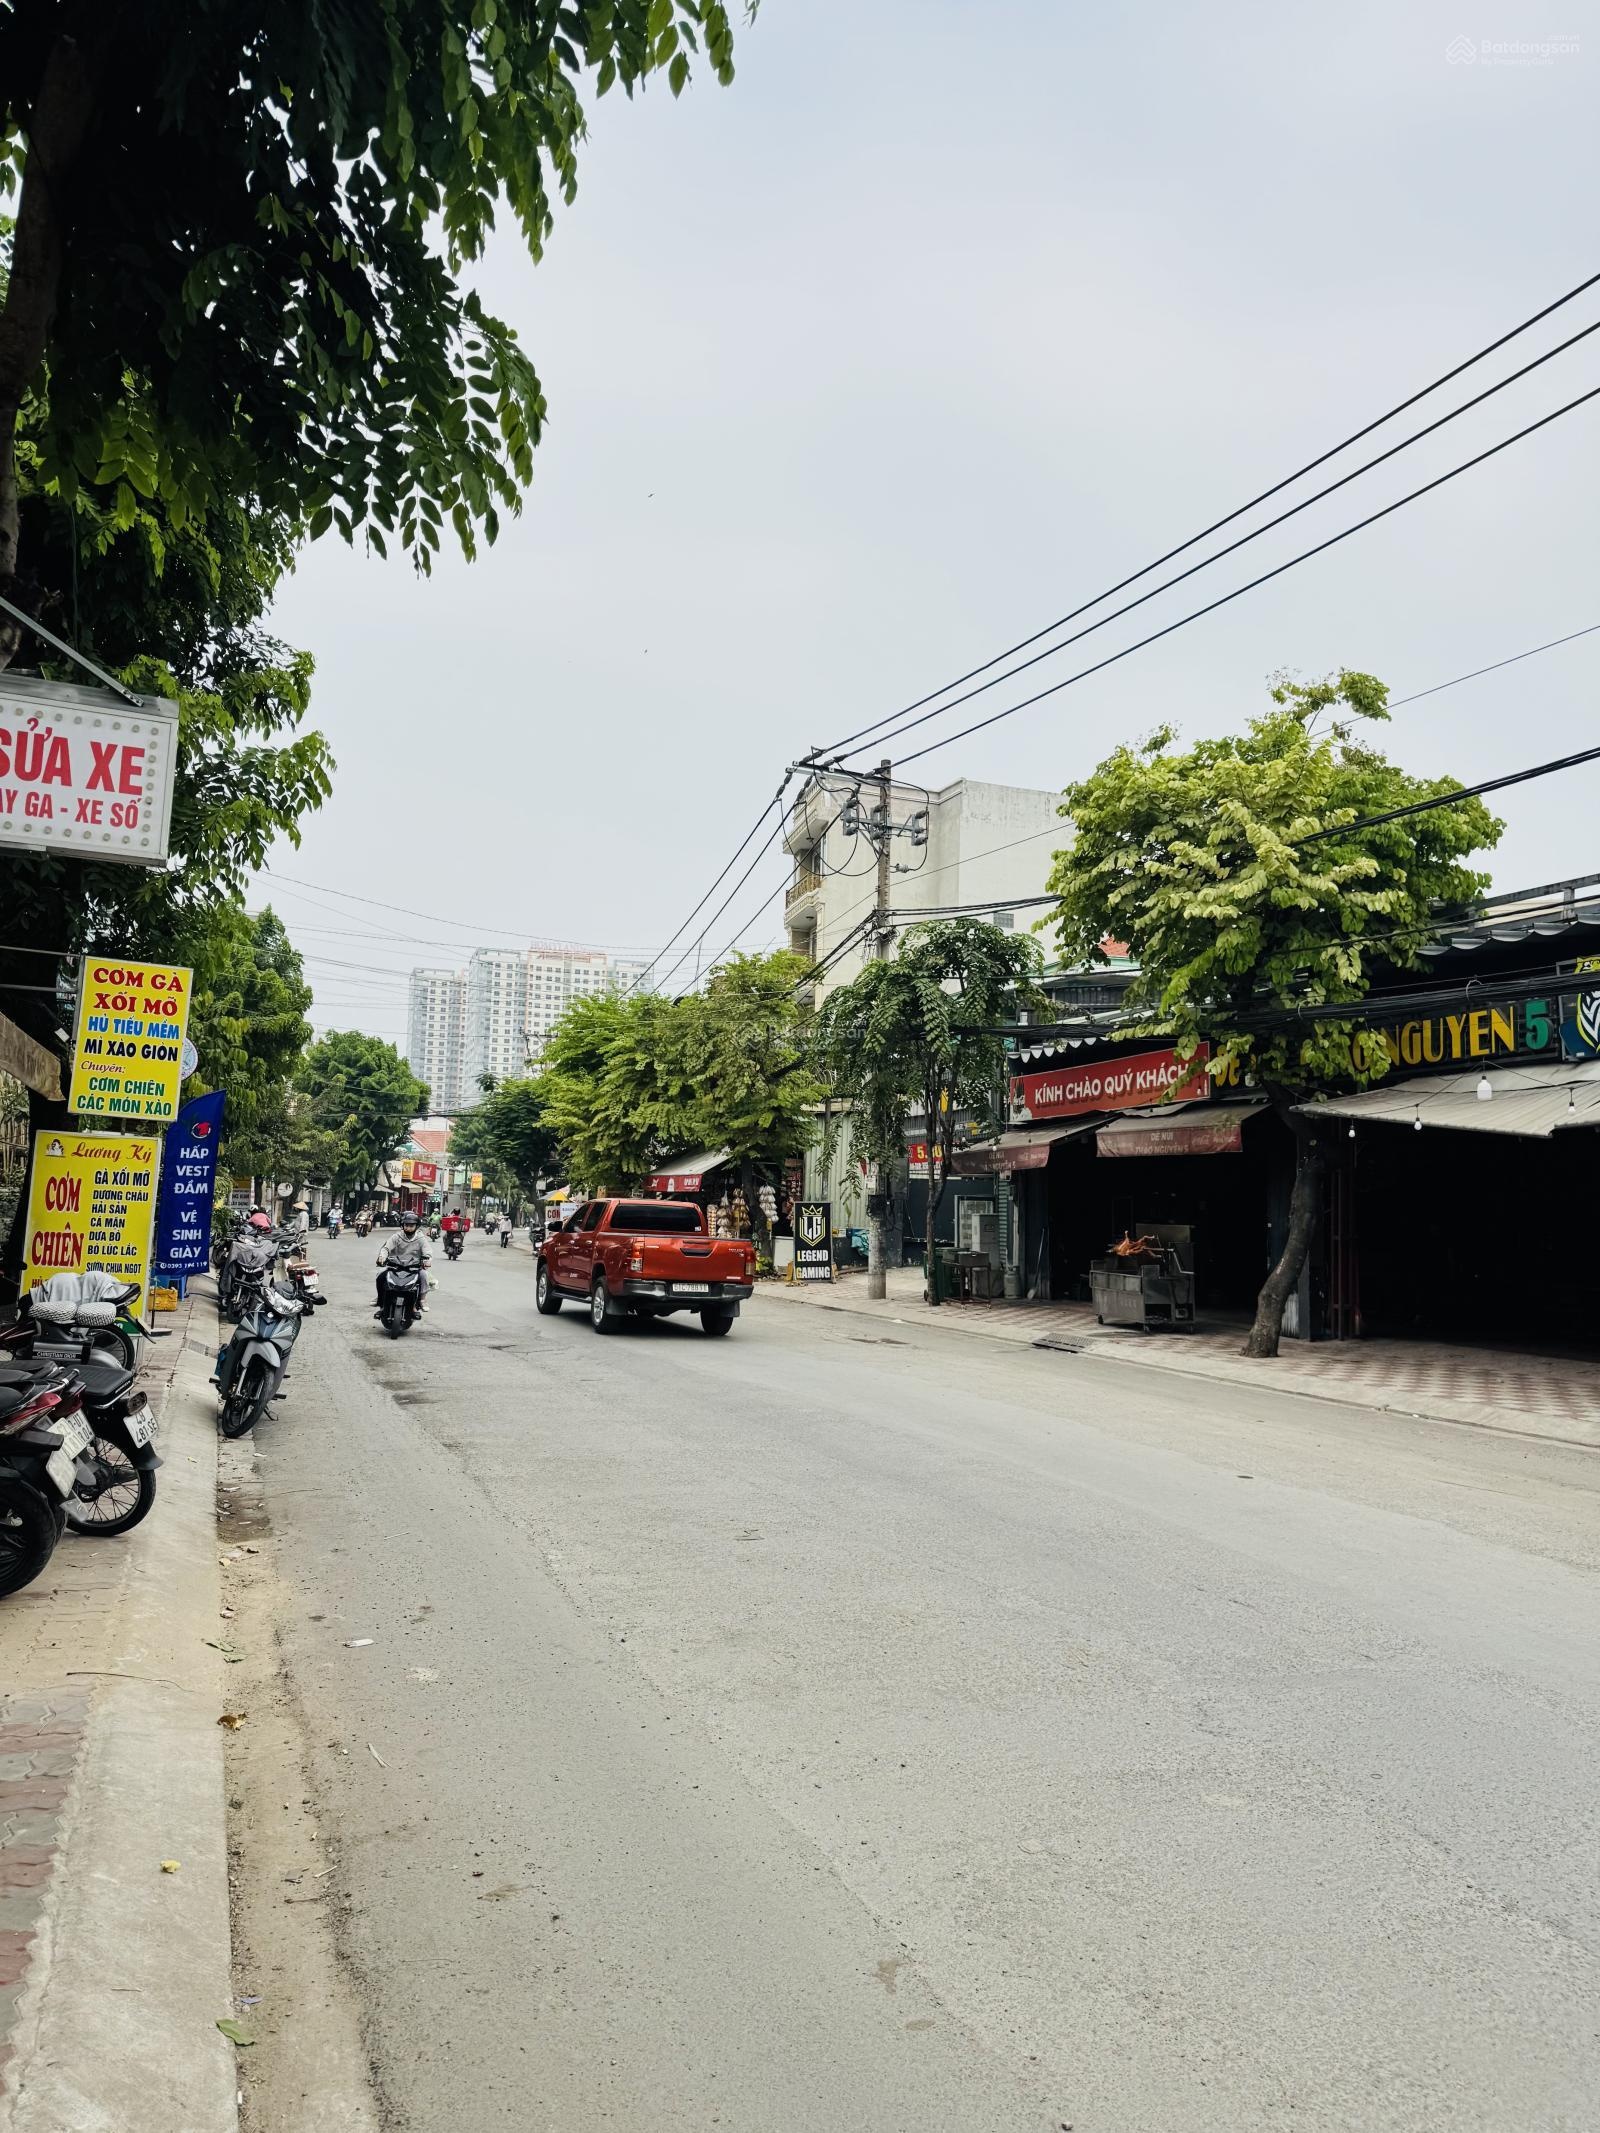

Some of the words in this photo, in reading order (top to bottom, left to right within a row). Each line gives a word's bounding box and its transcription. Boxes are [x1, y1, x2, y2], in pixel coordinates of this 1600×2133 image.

[86, 741, 145, 796] XE
[25, 792, 53, 819] GA
[75, 798, 103, 825] XE
[110, 798, 142, 829] SỐ
[93, 968, 144, 987] CƠM
[151, 972, 183, 992] GÀ
[93, 991, 137, 1012] XỐI
[143, 996, 178, 1016] MỠ
[88, 1014, 109, 1032] HỦ
[113, 1015, 143, 1035] TIẾU
[1526, 999, 1550, 1050] 5
[84, 1036, 103, 1054] MÌ
[106, 1038, 137, 1057] XÀO
[141, 1042, 179, 1061] GIÒN
[80, 1061, 126, 1074] Chuyên:
[89, 1077, 120, 1093] CƠM
[124, 1080, 165, 1096] CHIÊN
[1034, 1083, 1063, 1104] KÍNH
[1066, 1076, 1101, 1099] CHÀO
[1104, 1068, 1133, 1094] QUÝ
[77, 1094, 105, 1110] CÁC
[108, 1097, 141, 1113] MÓN
[144, 1099, 172, 1116] XÀO
[71, 1141, 121, 1162] Lương
[180, 1145, 209, 1159] HẤP
[94, 1168, 109, 1185] GÀ
[112, 1166, 130, 1186] XỐI
[132, 1170, 150, 1187] MỠ
[176, 1165, 210, 1177] VEST
[45, 1171, 82, 1212] CƠM
[93, 1189, 122, 1200] DƯƠNG
[91, 1201, 106, 1214] HẢI
[109, 1201, 127, 1214] SẢN
[181, 1210, 197, 1225] VỆ
[31, 1222, 84, 1267] CHIÊN
[172, 1229, 202, 1241] SINH
[170, 1246, 202, 1259] GIÀY
[797, 1250, 828, 1261] LEGEND
[796, 1266, 830, 1279] GAMING
